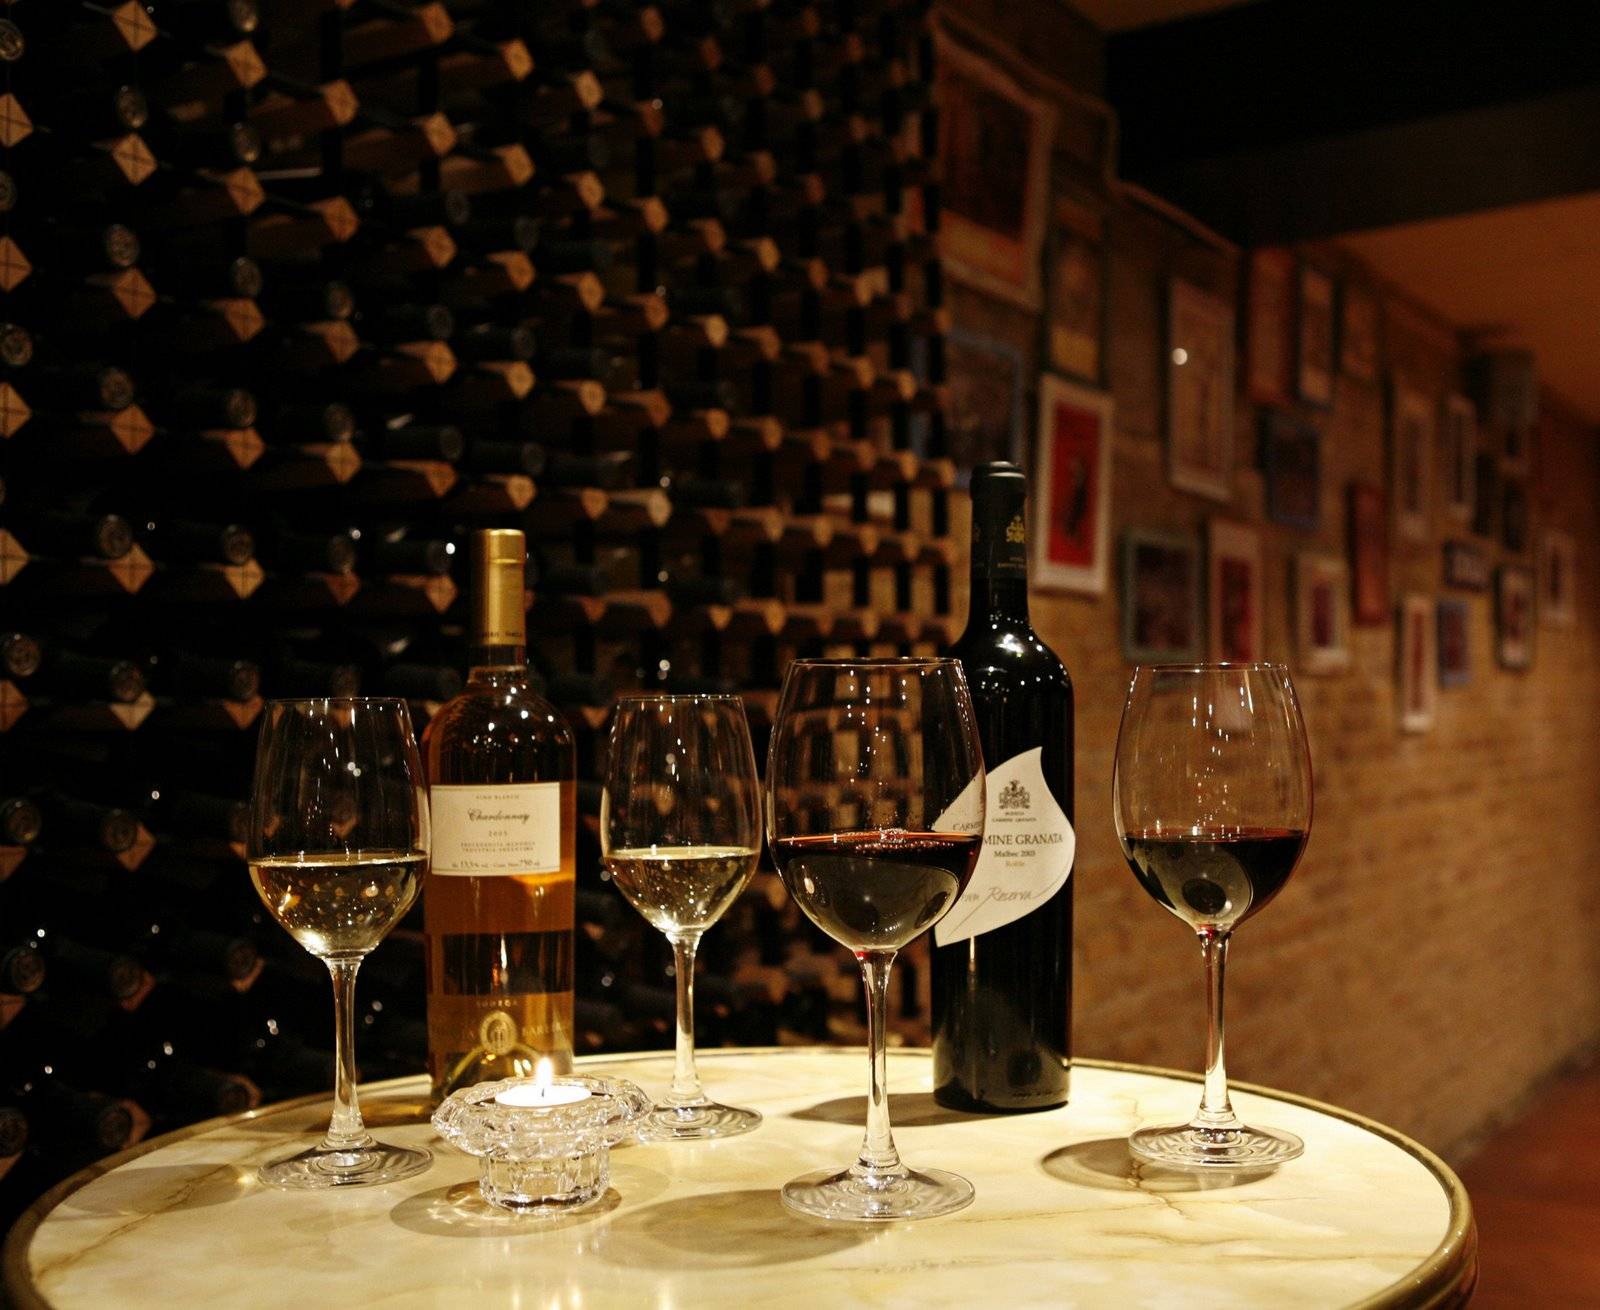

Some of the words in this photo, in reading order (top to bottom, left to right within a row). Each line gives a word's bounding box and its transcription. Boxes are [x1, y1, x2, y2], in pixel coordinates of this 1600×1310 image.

[467, 807, 530, 825] Chardonnay
[1015, 832, 1064, 846] GRANATA
[993, 849, 1019, 858] Malbec
